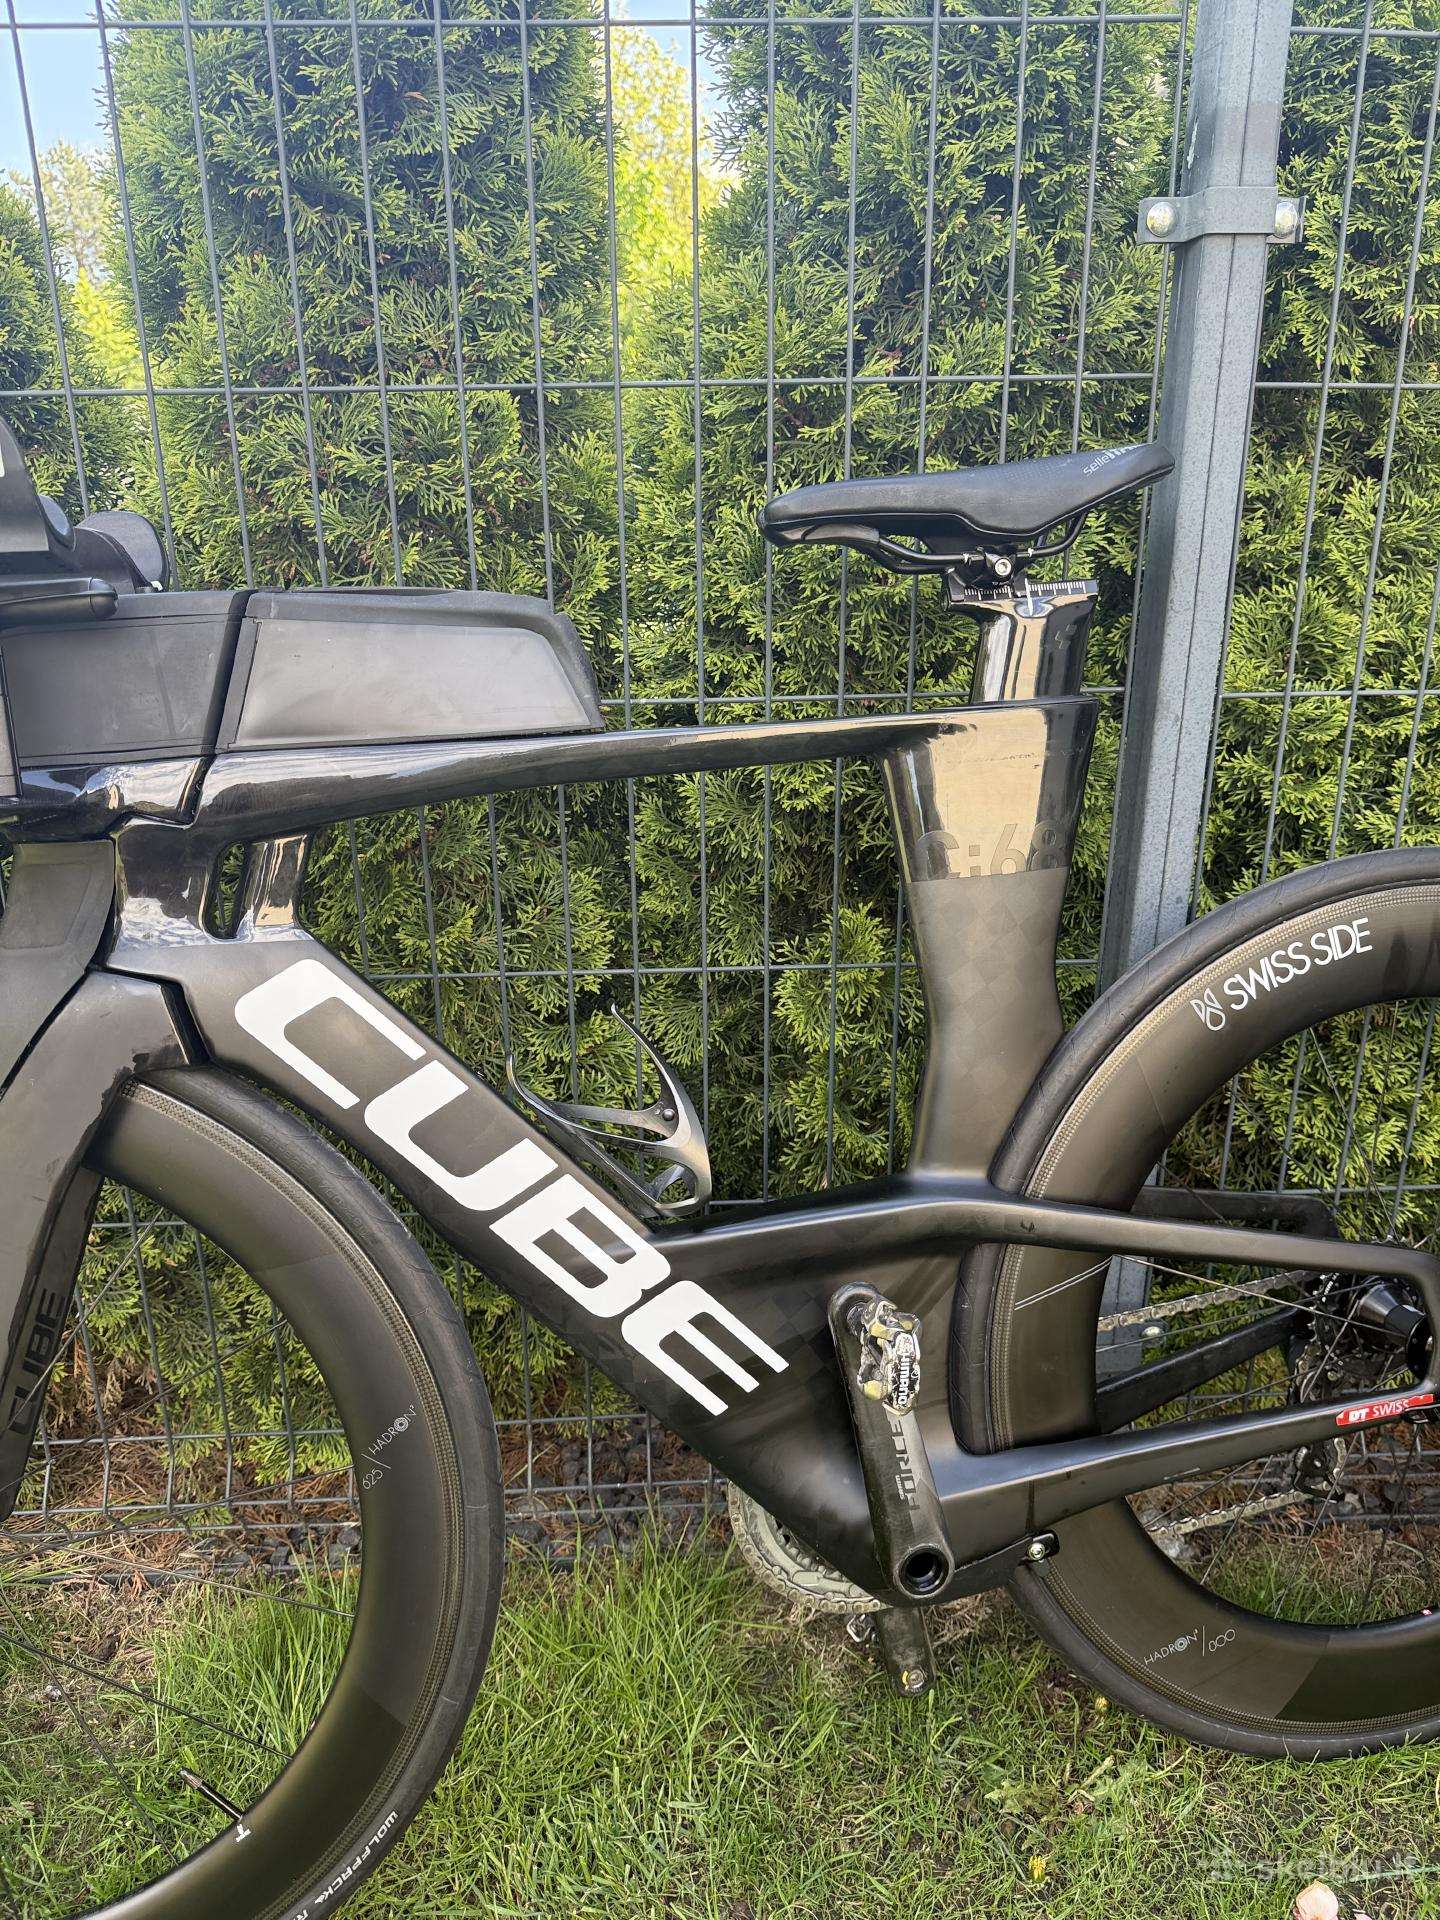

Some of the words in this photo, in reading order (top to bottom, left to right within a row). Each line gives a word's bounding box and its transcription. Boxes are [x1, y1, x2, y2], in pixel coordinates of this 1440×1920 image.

[1223, 941, 1312, 1010] SWISS
[1310, 917, 1373, 966] SIDE
[234, 959, 789, 1416] CUBE
[9, 1287, 66, 1435] CUBE
[897, 1348, 911, 1404] HIMANO
[1348, 1408, 1370, 1422] DT
[362, 1467, 384, 1490] 625
[891, 1419, 921, 1511] FORCE
[321, 1810, 399, 1901] WOLFPACK
